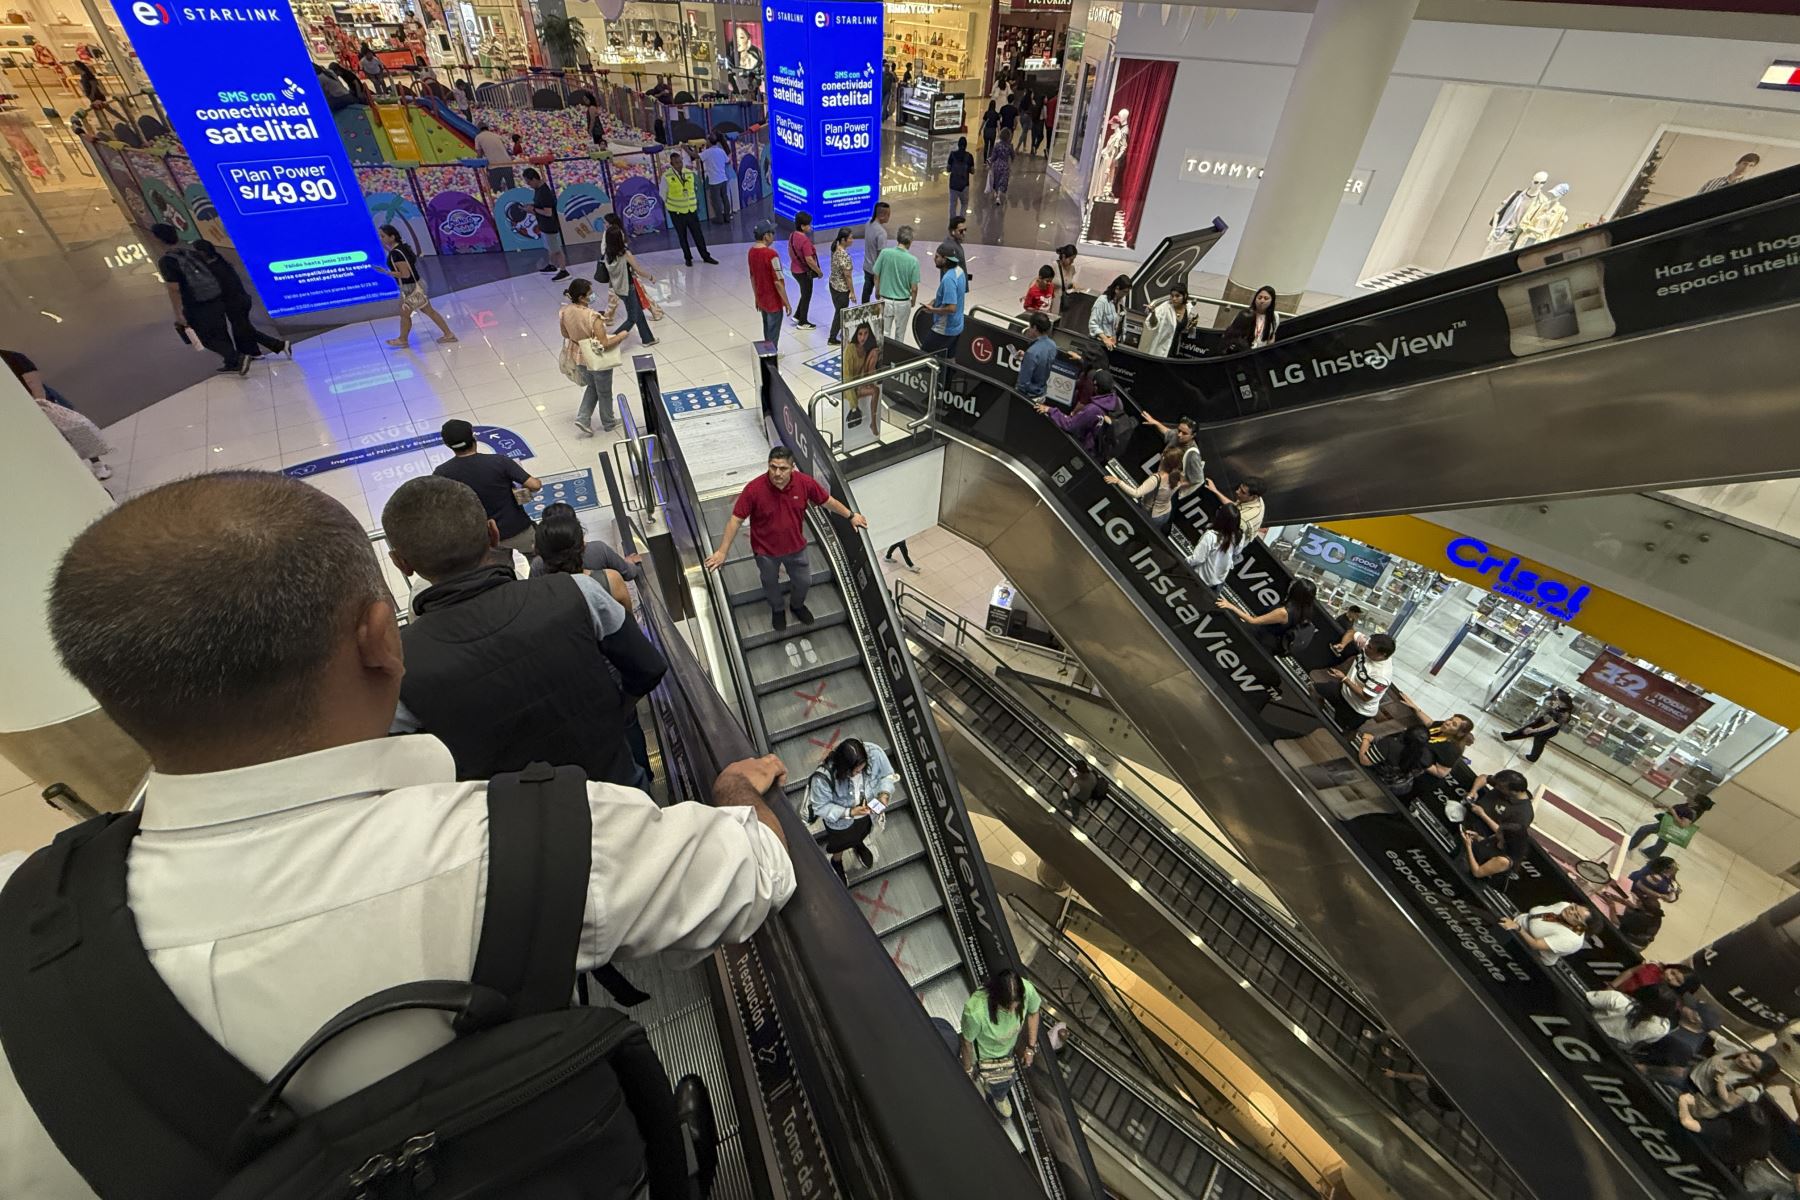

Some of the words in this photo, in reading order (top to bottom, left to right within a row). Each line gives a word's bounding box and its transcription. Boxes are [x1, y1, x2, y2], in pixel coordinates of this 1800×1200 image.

[183, 7, 281, 22] STARLINK
[777, 11, 804, 23] STARLINK
[835, 15, 878, 25] STARLINK
[772, 75, 804, 90] conectividad
[821, 80, 873, 91] conectividad
[834, 71, 849, 79] SMS
[217, 91, 249, 103] SMS
[251, 92, 276, 102] con
[773, 87, 805, 107] satelital
[821, 90, 873, 108] satelital
[196, 102, 310, 121] conectividad
[205, 118, 319, 145] satelital
[776, 115, 788, 128] Plan
[787, 118, 804, 133] Power
[825, 124, 843, 134] Plan
[844, 122, 870, 133] Power
[776, 126, 804, 150] S/49.90
[825, 133, 870, 150] S/49.90
[230, 168, 272, 184] Plan
[272, 165, 326, 180] Power
[1187, 159, 1257, 179] TOMMY
[239, 178, 337, 205] S/49.90
[1655, 261, 1695, 280] Haz
[1698, 253, 1726, 270] de
[1730, 246, 1753, 261] tu
[1656, 269, 1739, 297] espacio
[1743, 252, 1800, 277] inteli
[996, 345, 1023, 373] LG
[1268, 363, 1306, 389] LG
[794, 421, 809, 459] LG
[330, 453, 366, 466] Ingreso
[366, 451, 376, 459] al
[376, 445, 400, 456] Nivel
[1087, 497, 1136, 547] LG
[1446, 537, 1591, 614] Crisol
[877, 618, 904, 681] LG
[876, 666, 890, 698] Precaución
[1520, 860, 1542, 878] un
[1385, 850, 1439, 905] espacio
[1434, 906, 1506, 982] inteligente
[1407, 848, 1438, 877] Haz
[1433, 878, 1455, 897] de
[1452, 899, 1472, 914] tu
[1470, 916, 1514, 960] hogar
[1507, 962, 1531, 981] un
[968, 936, 984, 976] Precaución
[736, 952, 765, 1032] Precaución
[1529, 1014, 1601, 1063] LG
[1582, 1074, 1727, 1200] InstaVi
[782, 1106, 804, 1167] Tome
[798, 1165, 814, 1197] de
